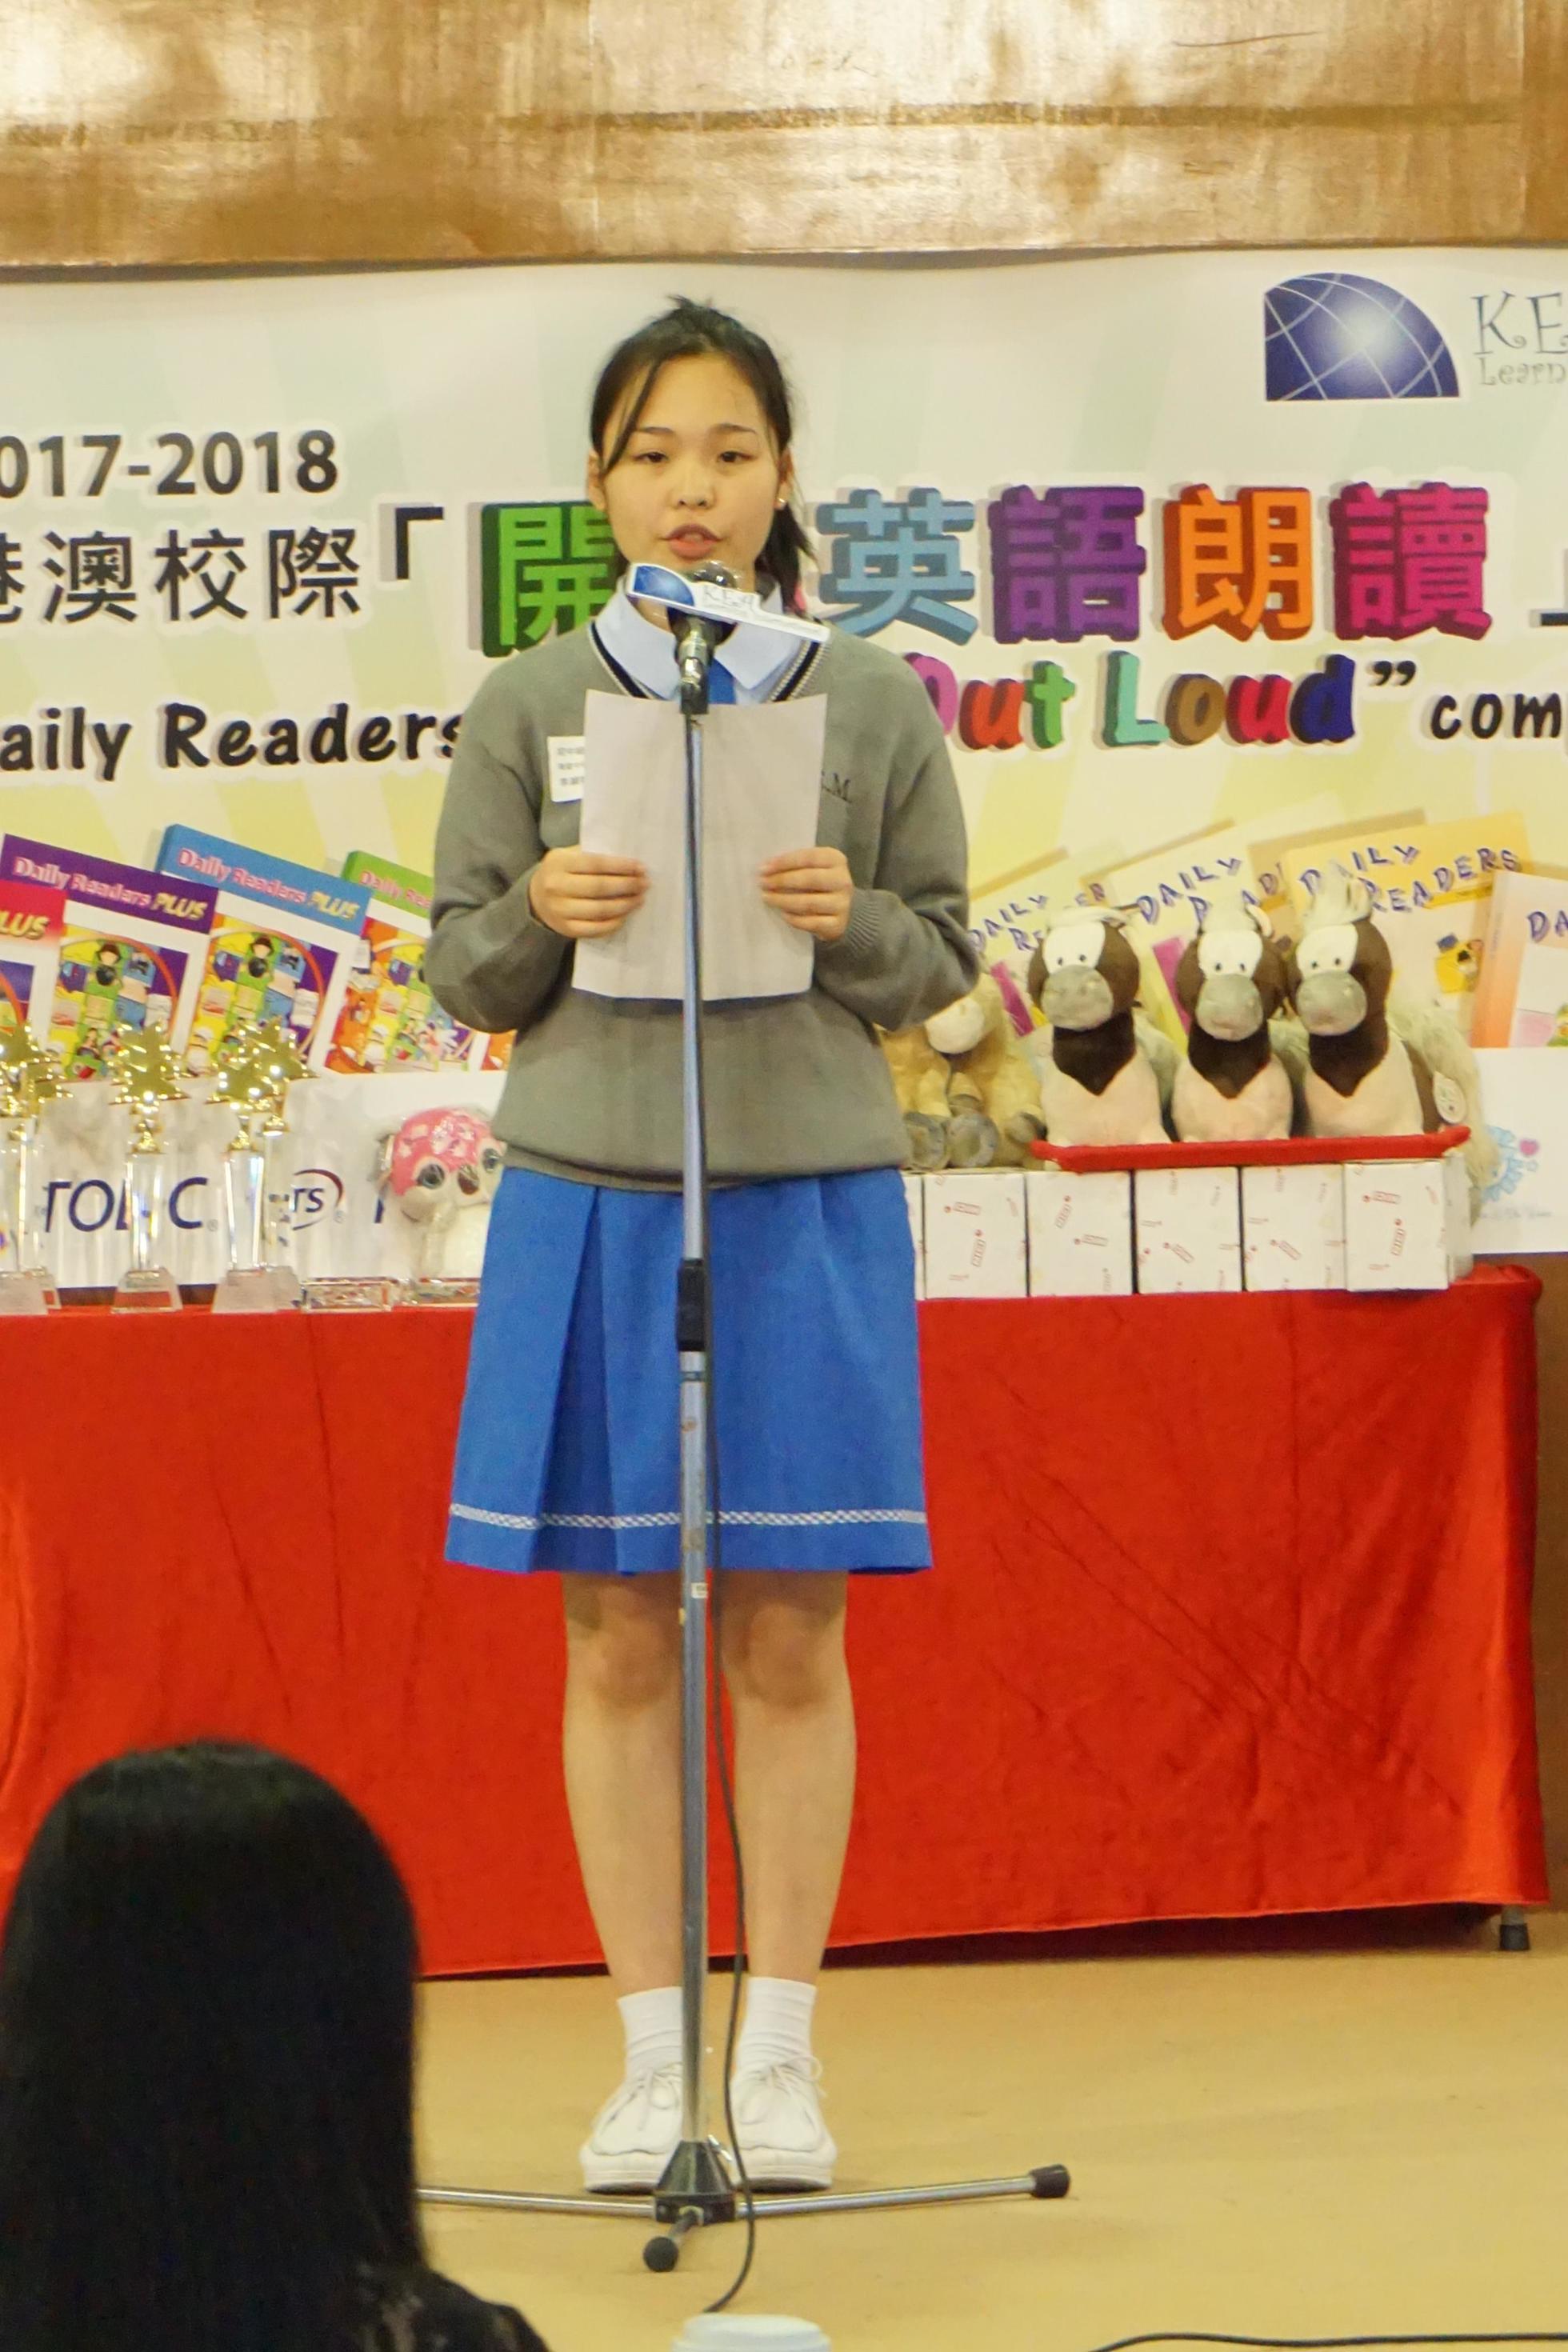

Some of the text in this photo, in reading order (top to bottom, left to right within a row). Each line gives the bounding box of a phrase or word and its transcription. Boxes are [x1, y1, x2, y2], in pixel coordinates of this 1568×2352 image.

[1470, 290, 1568, 354] KE
[1430, 692, 1563, 740] com
[13, 856, 208, 920] Daily Readers PLUS
[178, 847, 360, 919] Daily Readers PLUS
[1136, 858, 1242, 924] DAILY
[1299, 845, 1419, 897] DILY
